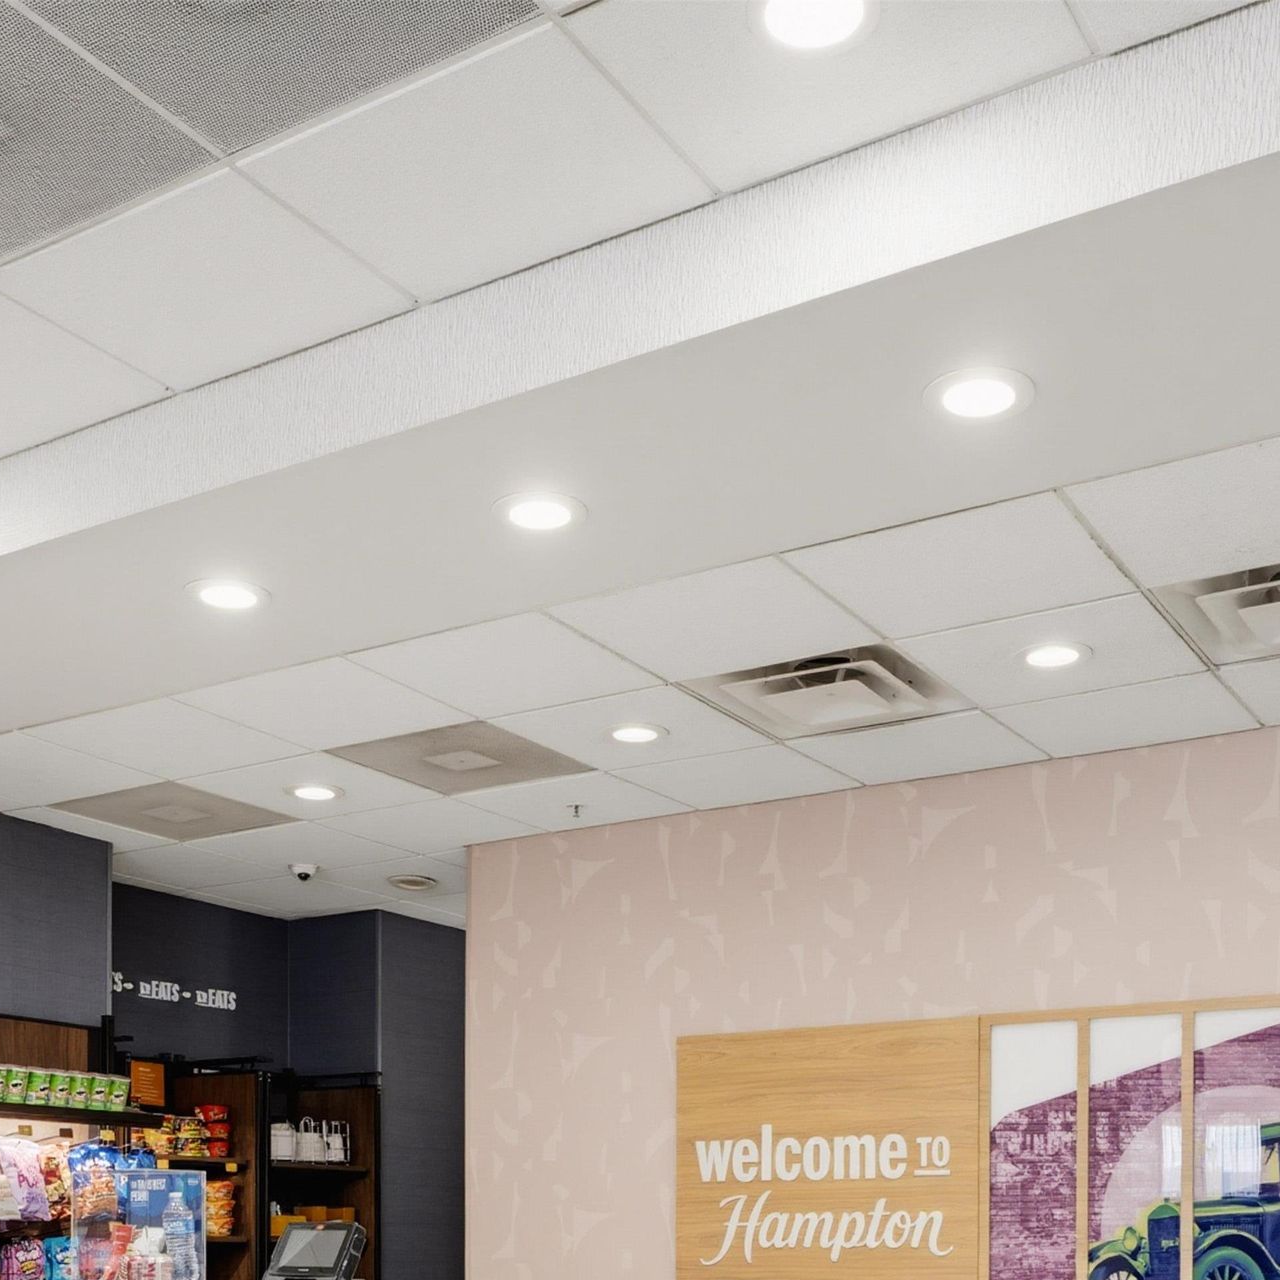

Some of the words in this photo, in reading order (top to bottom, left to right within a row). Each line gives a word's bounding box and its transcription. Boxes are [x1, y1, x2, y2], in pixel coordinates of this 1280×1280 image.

[694, 1124, 908, 1183] welcome
[913, 1136, 951, 1177] TO
[699, 1190, 954, 1266] Hampton
